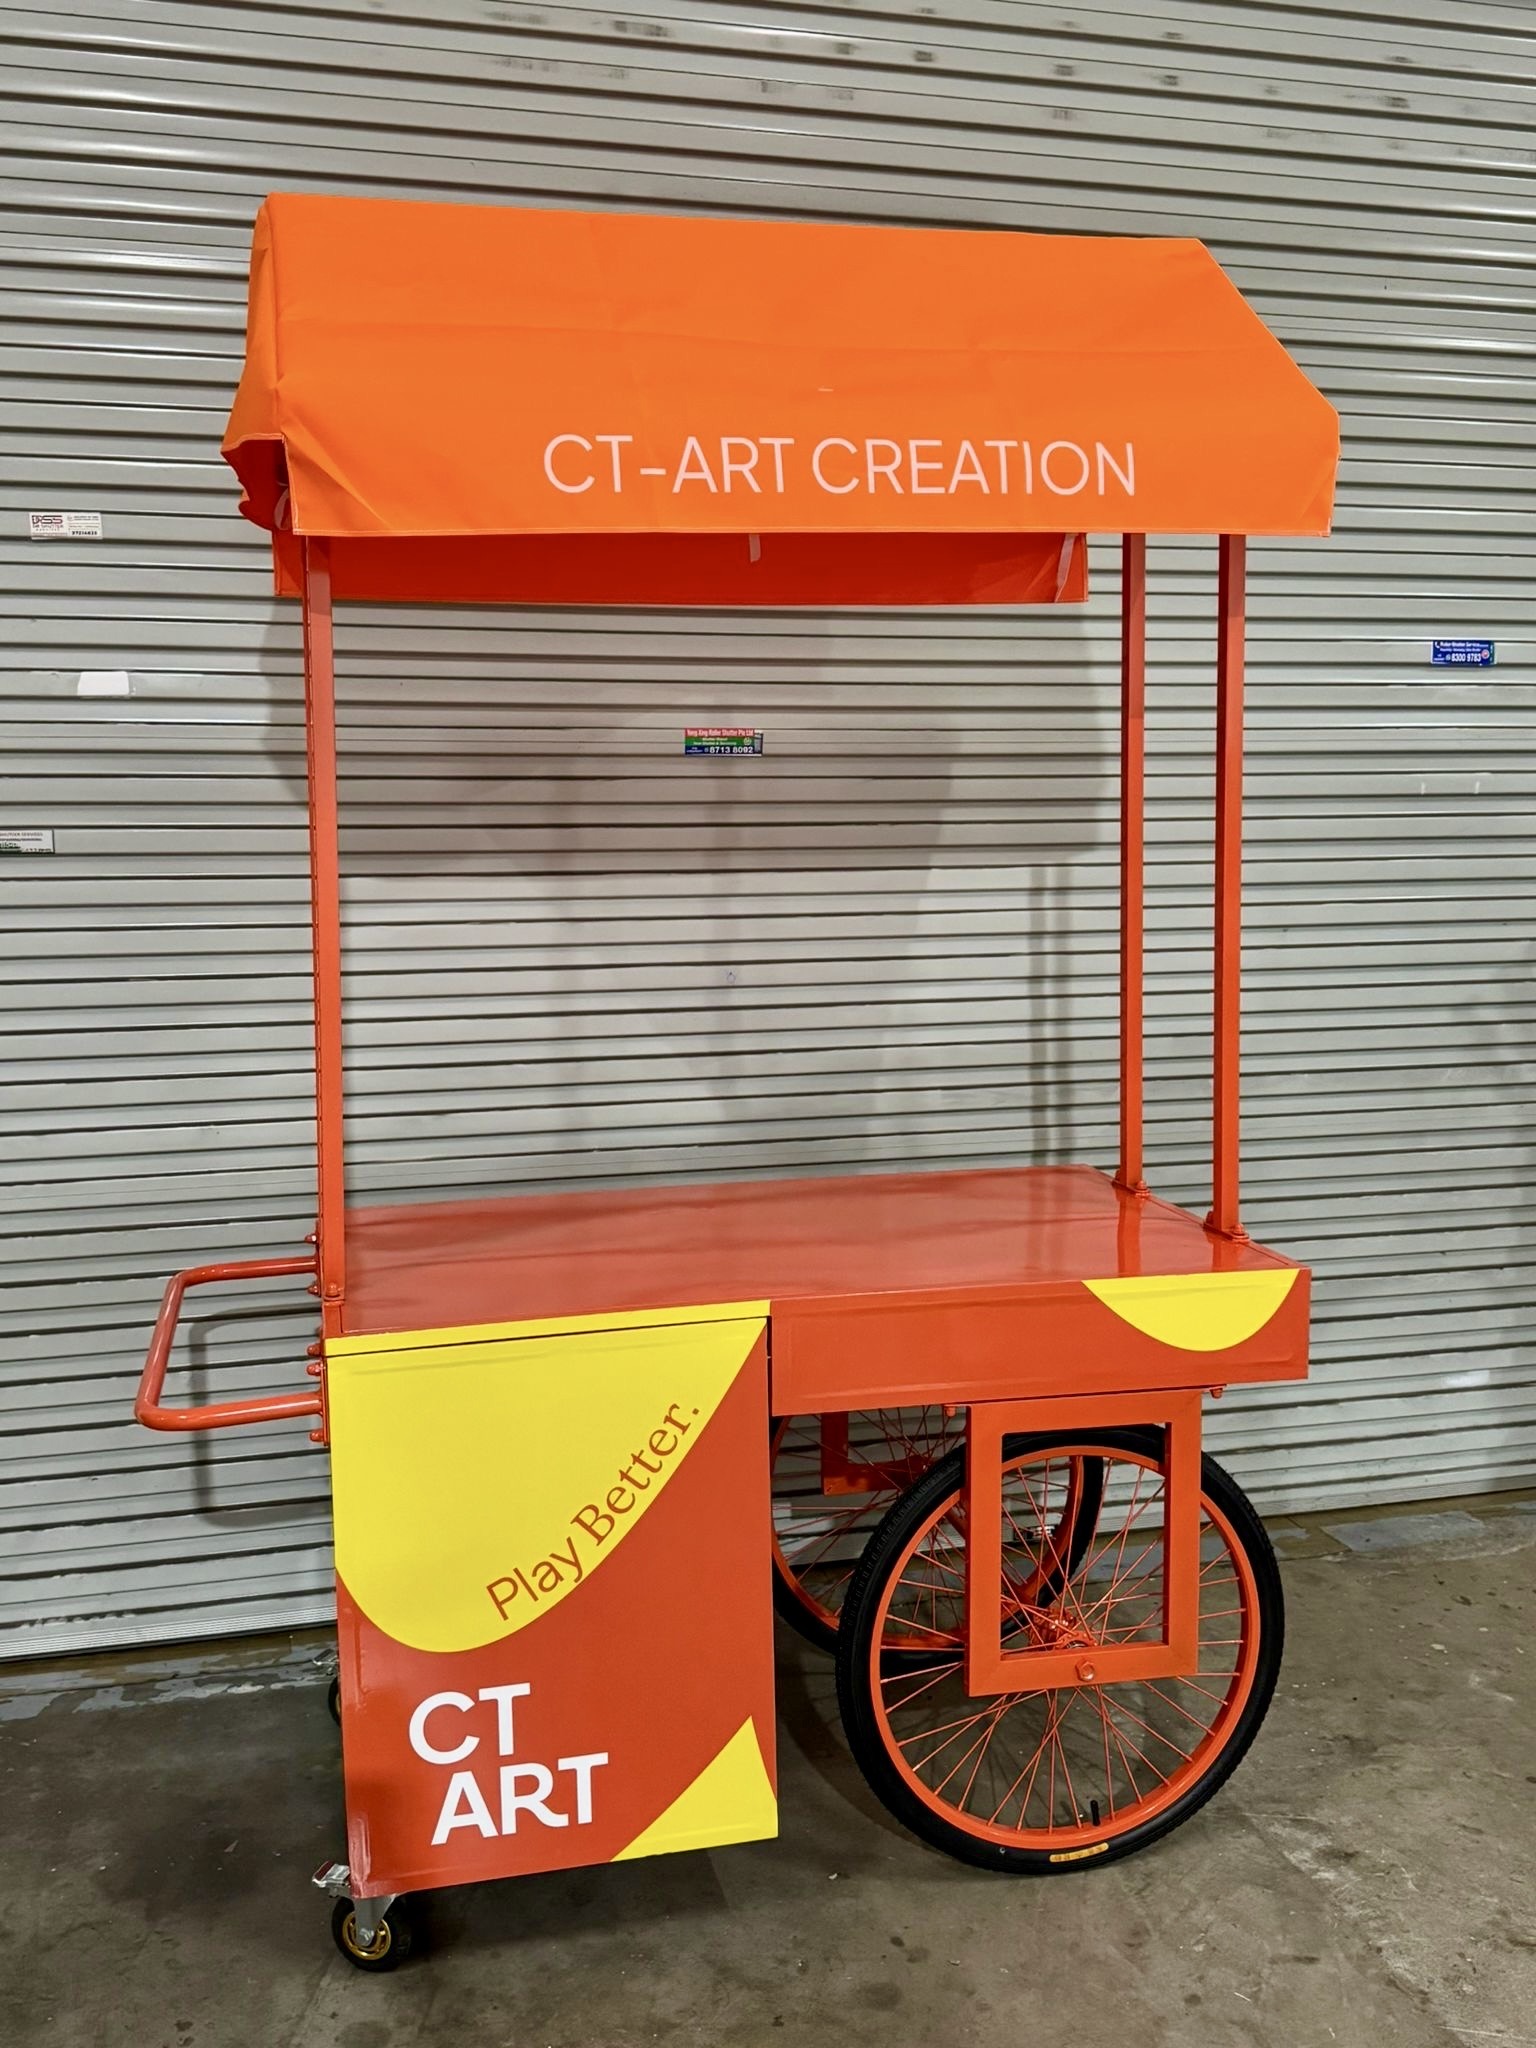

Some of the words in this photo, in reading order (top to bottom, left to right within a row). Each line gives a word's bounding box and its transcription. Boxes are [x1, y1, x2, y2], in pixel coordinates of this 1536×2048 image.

[543, 434, 795, 494] CT-ART
[812, 437, 1135, 496] CREATION
[486, 1536, 583, 1621] Play
[570, 1403, 700, 1547] Better.
[408, 1682, 531, 1765] CT
[431, 1752, 609, 1846] ART
